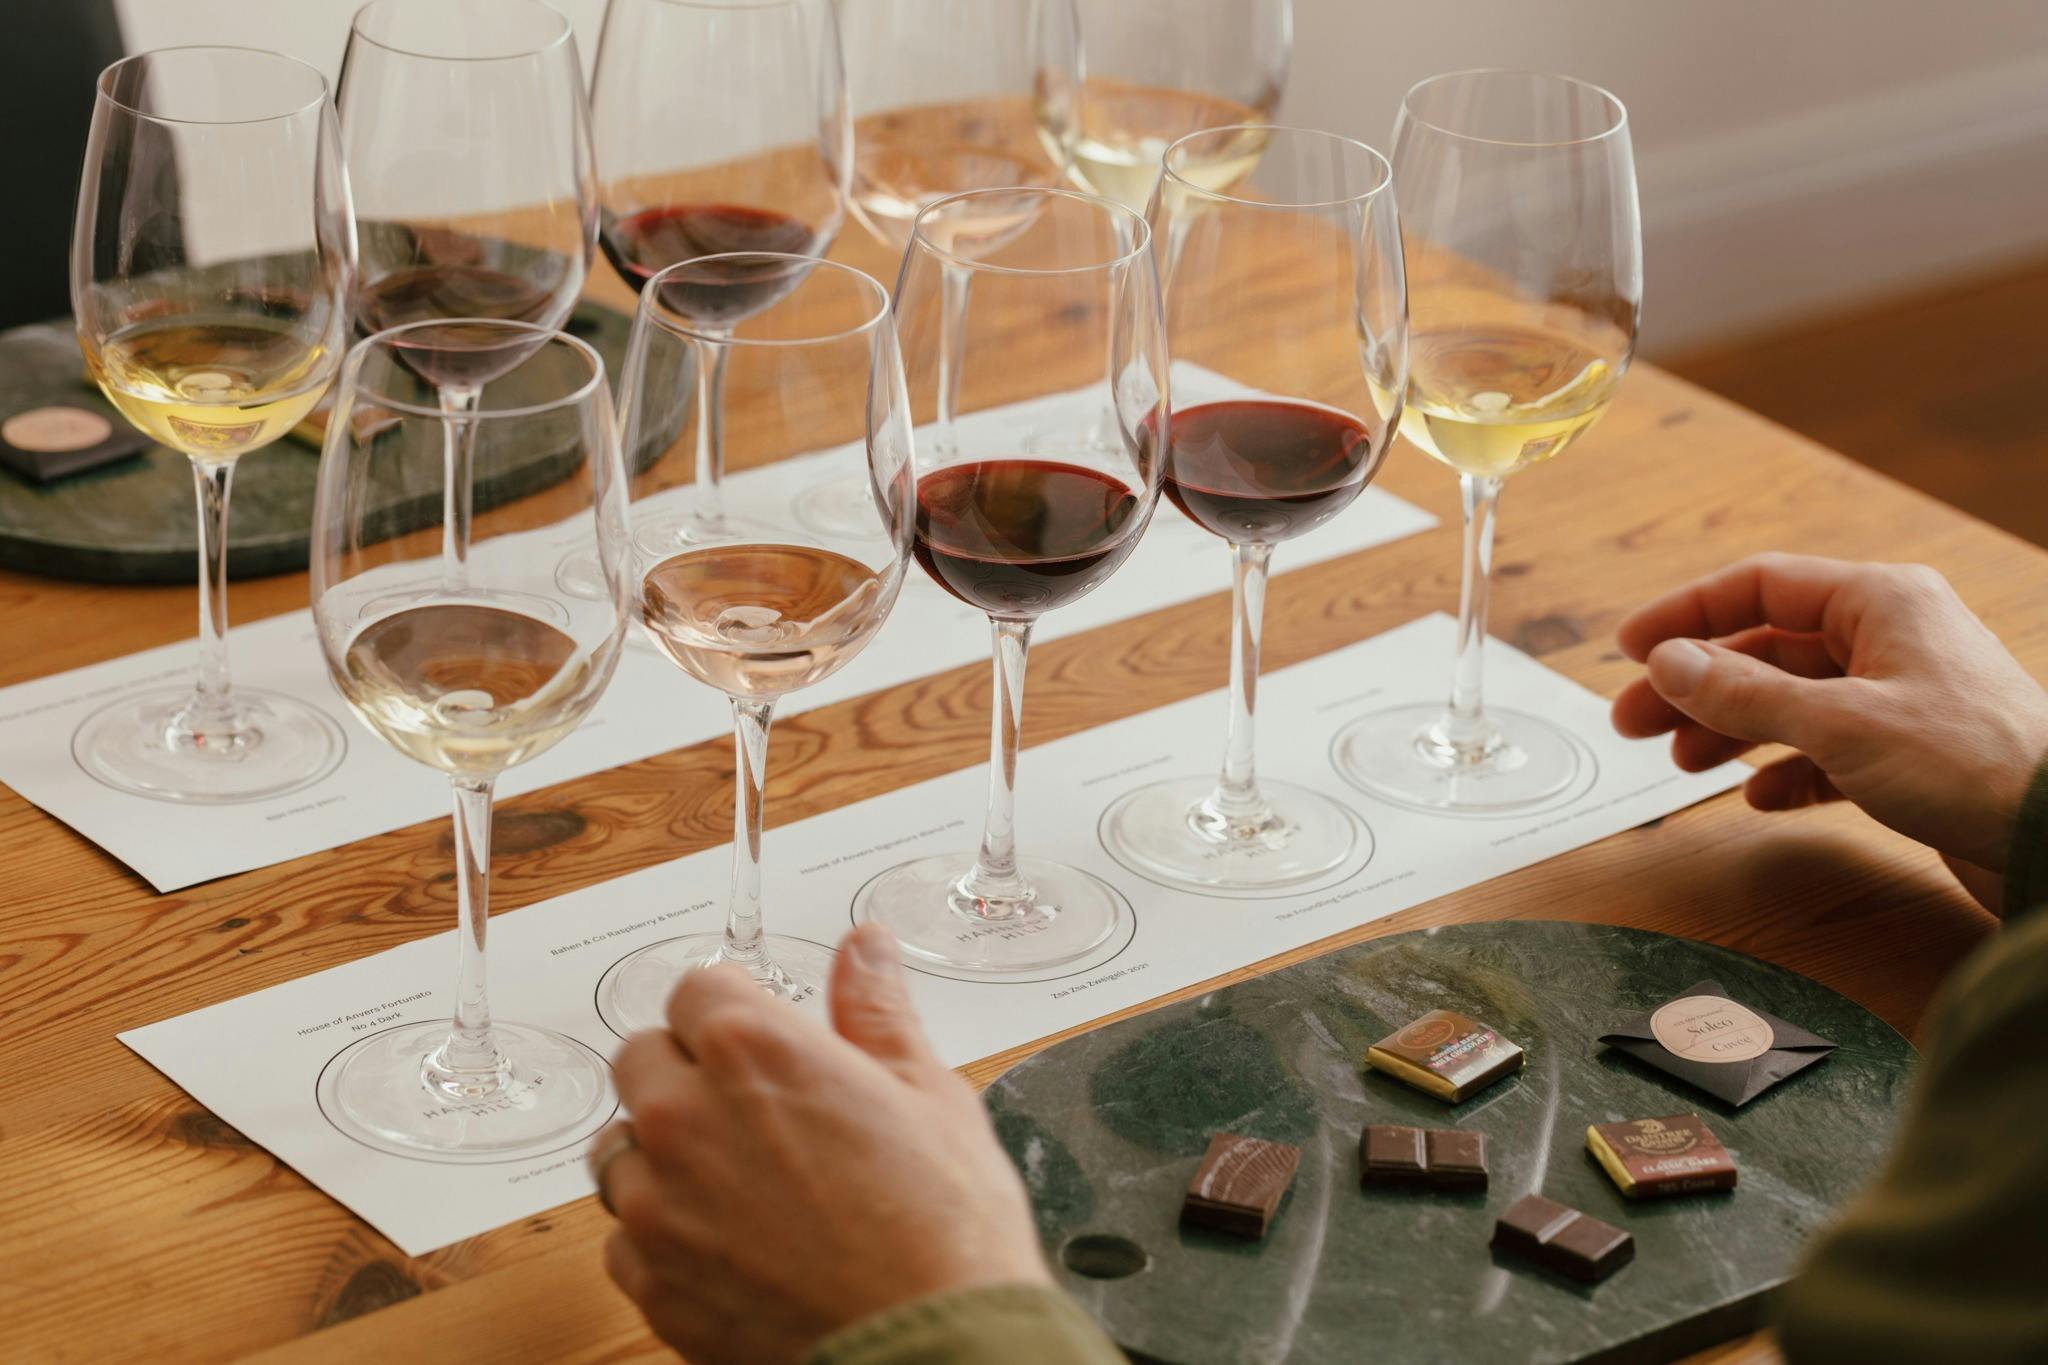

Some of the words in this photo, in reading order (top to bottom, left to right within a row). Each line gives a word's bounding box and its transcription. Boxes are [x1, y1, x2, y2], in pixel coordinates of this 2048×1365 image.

[592, 934, 606, 943] Co
[607, 919, 657, 938] Raspberry
[692, 900, 715, 911] Dark
[297, 1021, 331, 1036] House
[332, 1016, 342, 1027] of
[345, 1007, 380, 1022] Anvers
[381, 990, 432, 1010] Fortunato
[351, 1023, 367, 1032] No
[377, 1012, 402, 1024] Dark
